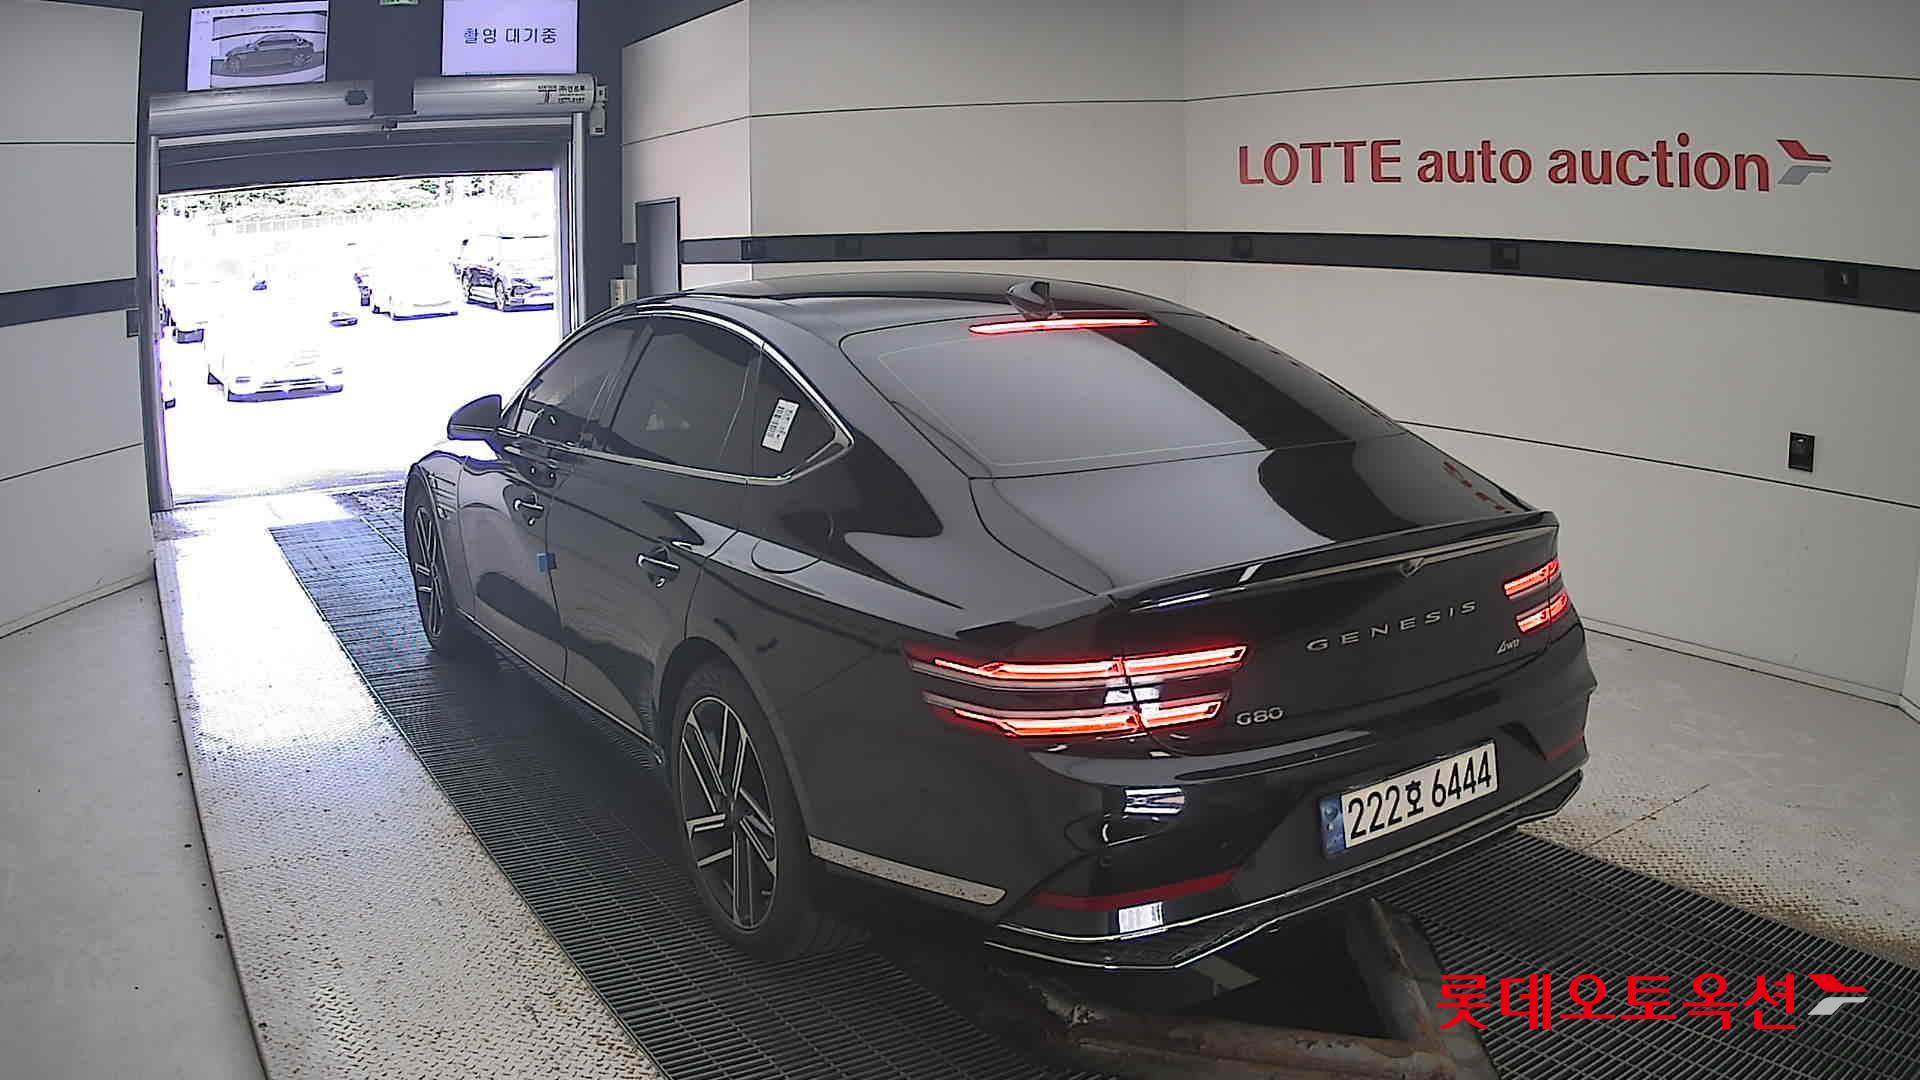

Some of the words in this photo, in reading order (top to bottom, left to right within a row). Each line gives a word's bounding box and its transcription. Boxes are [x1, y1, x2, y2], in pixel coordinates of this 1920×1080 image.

[505, 27, 558, 44] 대기중
[1238, 138, 1402, 186] LOTTE
[1416, 139, 1533, 185] auto
[1547, 132, 1771, 193] auction
[1305, 600, 1477, 651] GENESIS
[1235, 706, 1285, 727] G80
[1348, 780, 1424, 840] 222호
[1431, 750, 1492, 808] 6444
